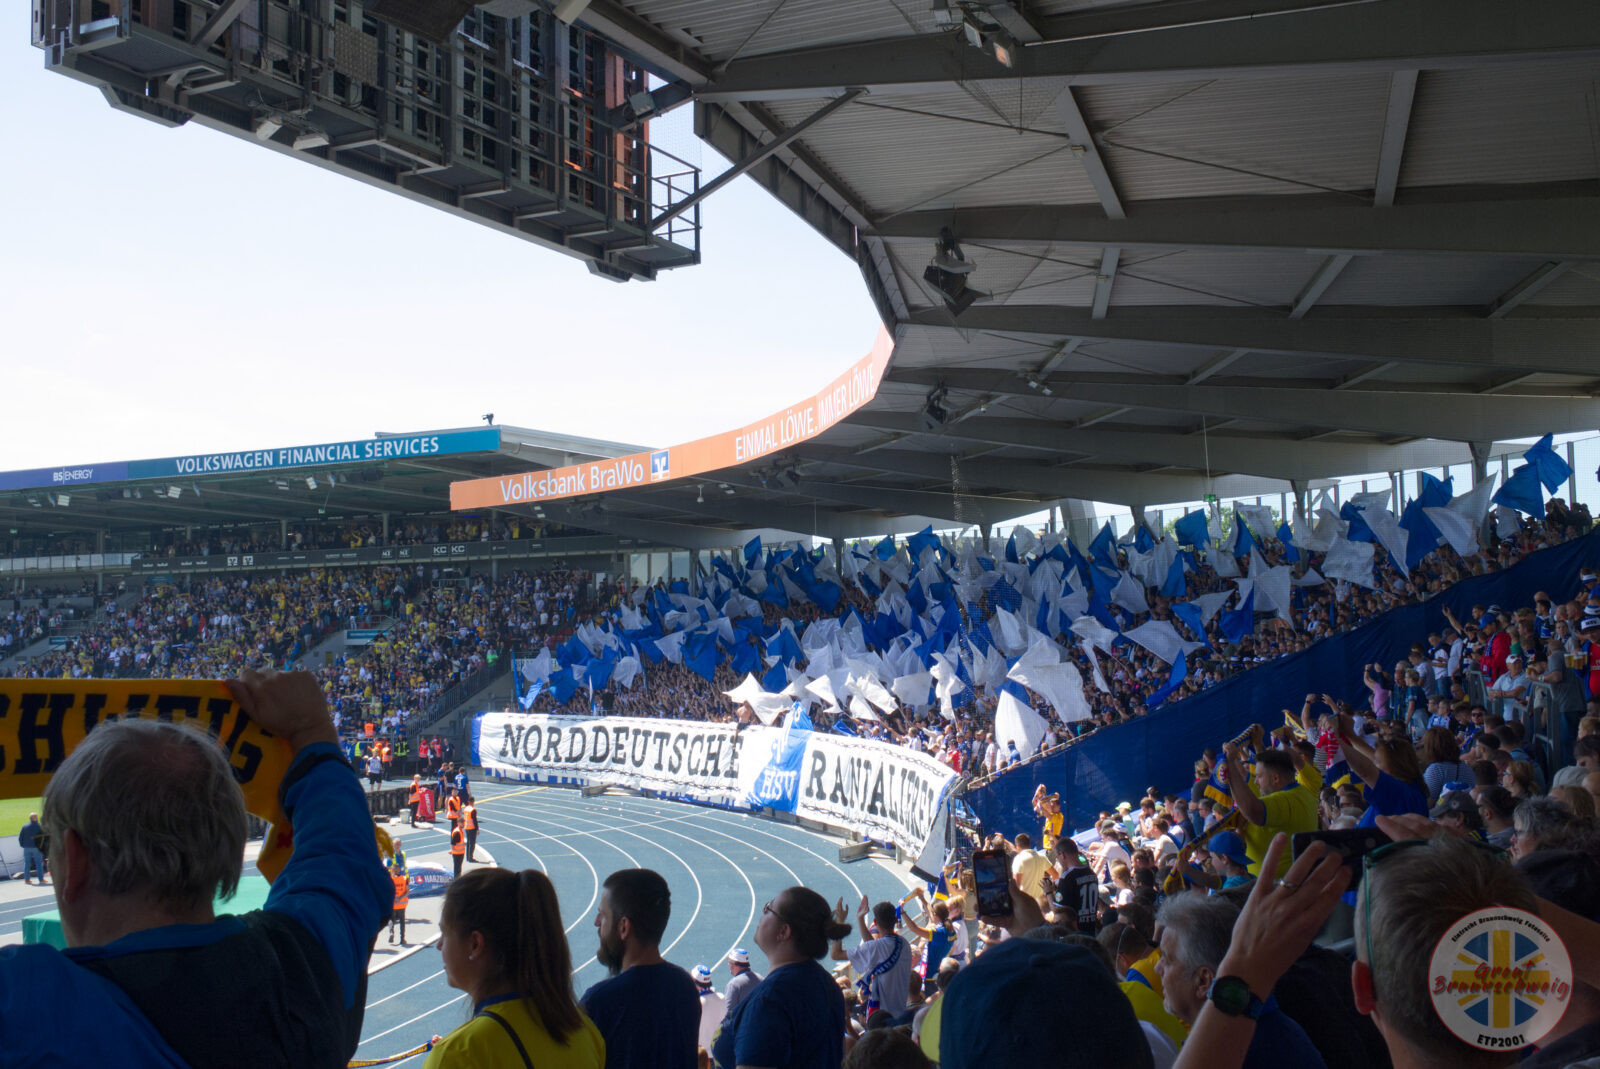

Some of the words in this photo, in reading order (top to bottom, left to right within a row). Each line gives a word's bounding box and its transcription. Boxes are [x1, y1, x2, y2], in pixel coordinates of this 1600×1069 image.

[735, 423, 778, 461] EINMAL
[818, 384, 847, 429] IMMER
[176, 451, 273, 473] VOLKSWAGEN
[279, 444, 360, 465] FINANCIAL
[364, 437, 439, 458] SERVICES
[500, 466, 586, 502] Volksbank
[590, 459, 644, 489] BraWo
[760, 769, 797, 800] HSV
[1079, 882, 1098, 916] 10
